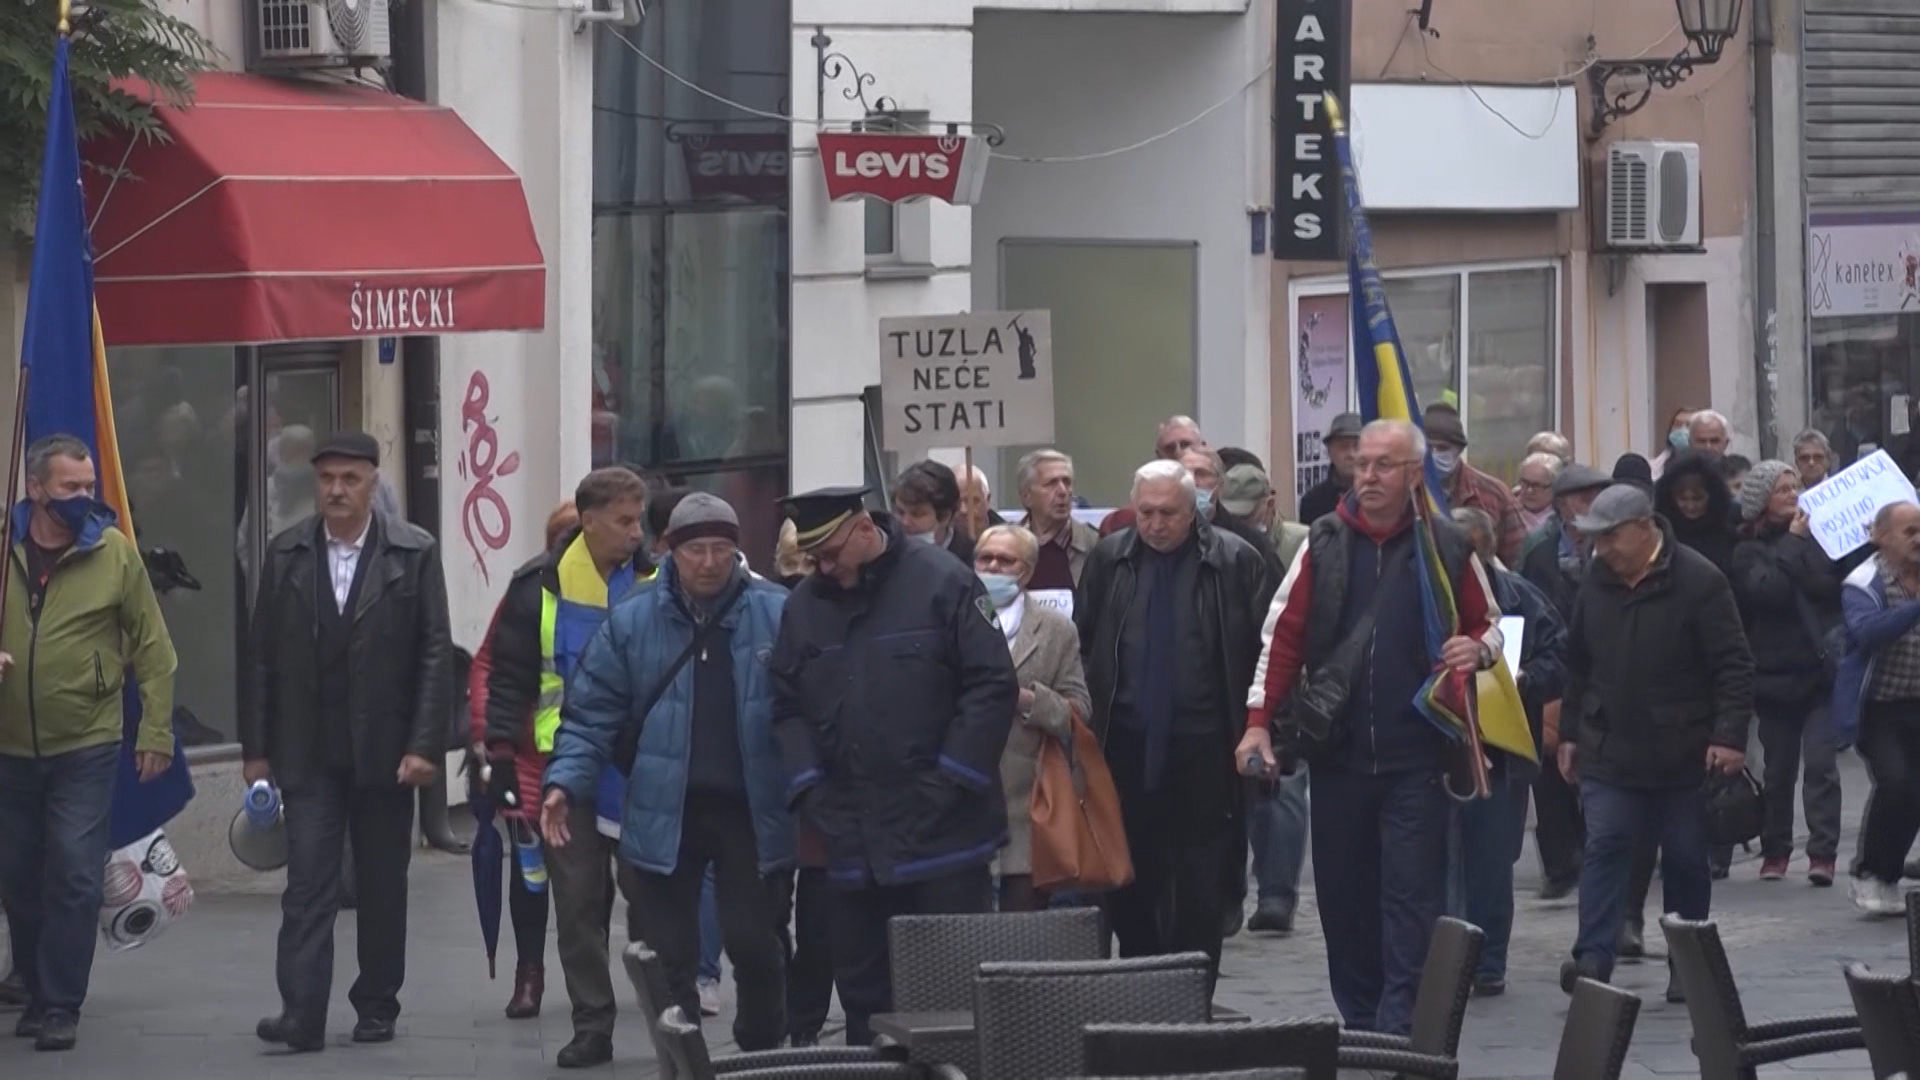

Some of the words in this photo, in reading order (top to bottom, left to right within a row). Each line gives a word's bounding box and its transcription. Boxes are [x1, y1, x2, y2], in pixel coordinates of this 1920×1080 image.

[1292, 0, 1325, 240] ARTEKS
[1835, 261, 1894, 284] kanetex
[351, 281, 455, 331] ŠIMECKI
[888, 327, 1004, 358] TUZLA
[913, 358, 990, 390] NEĆE
[904, 400, 1005, 434] STATI
